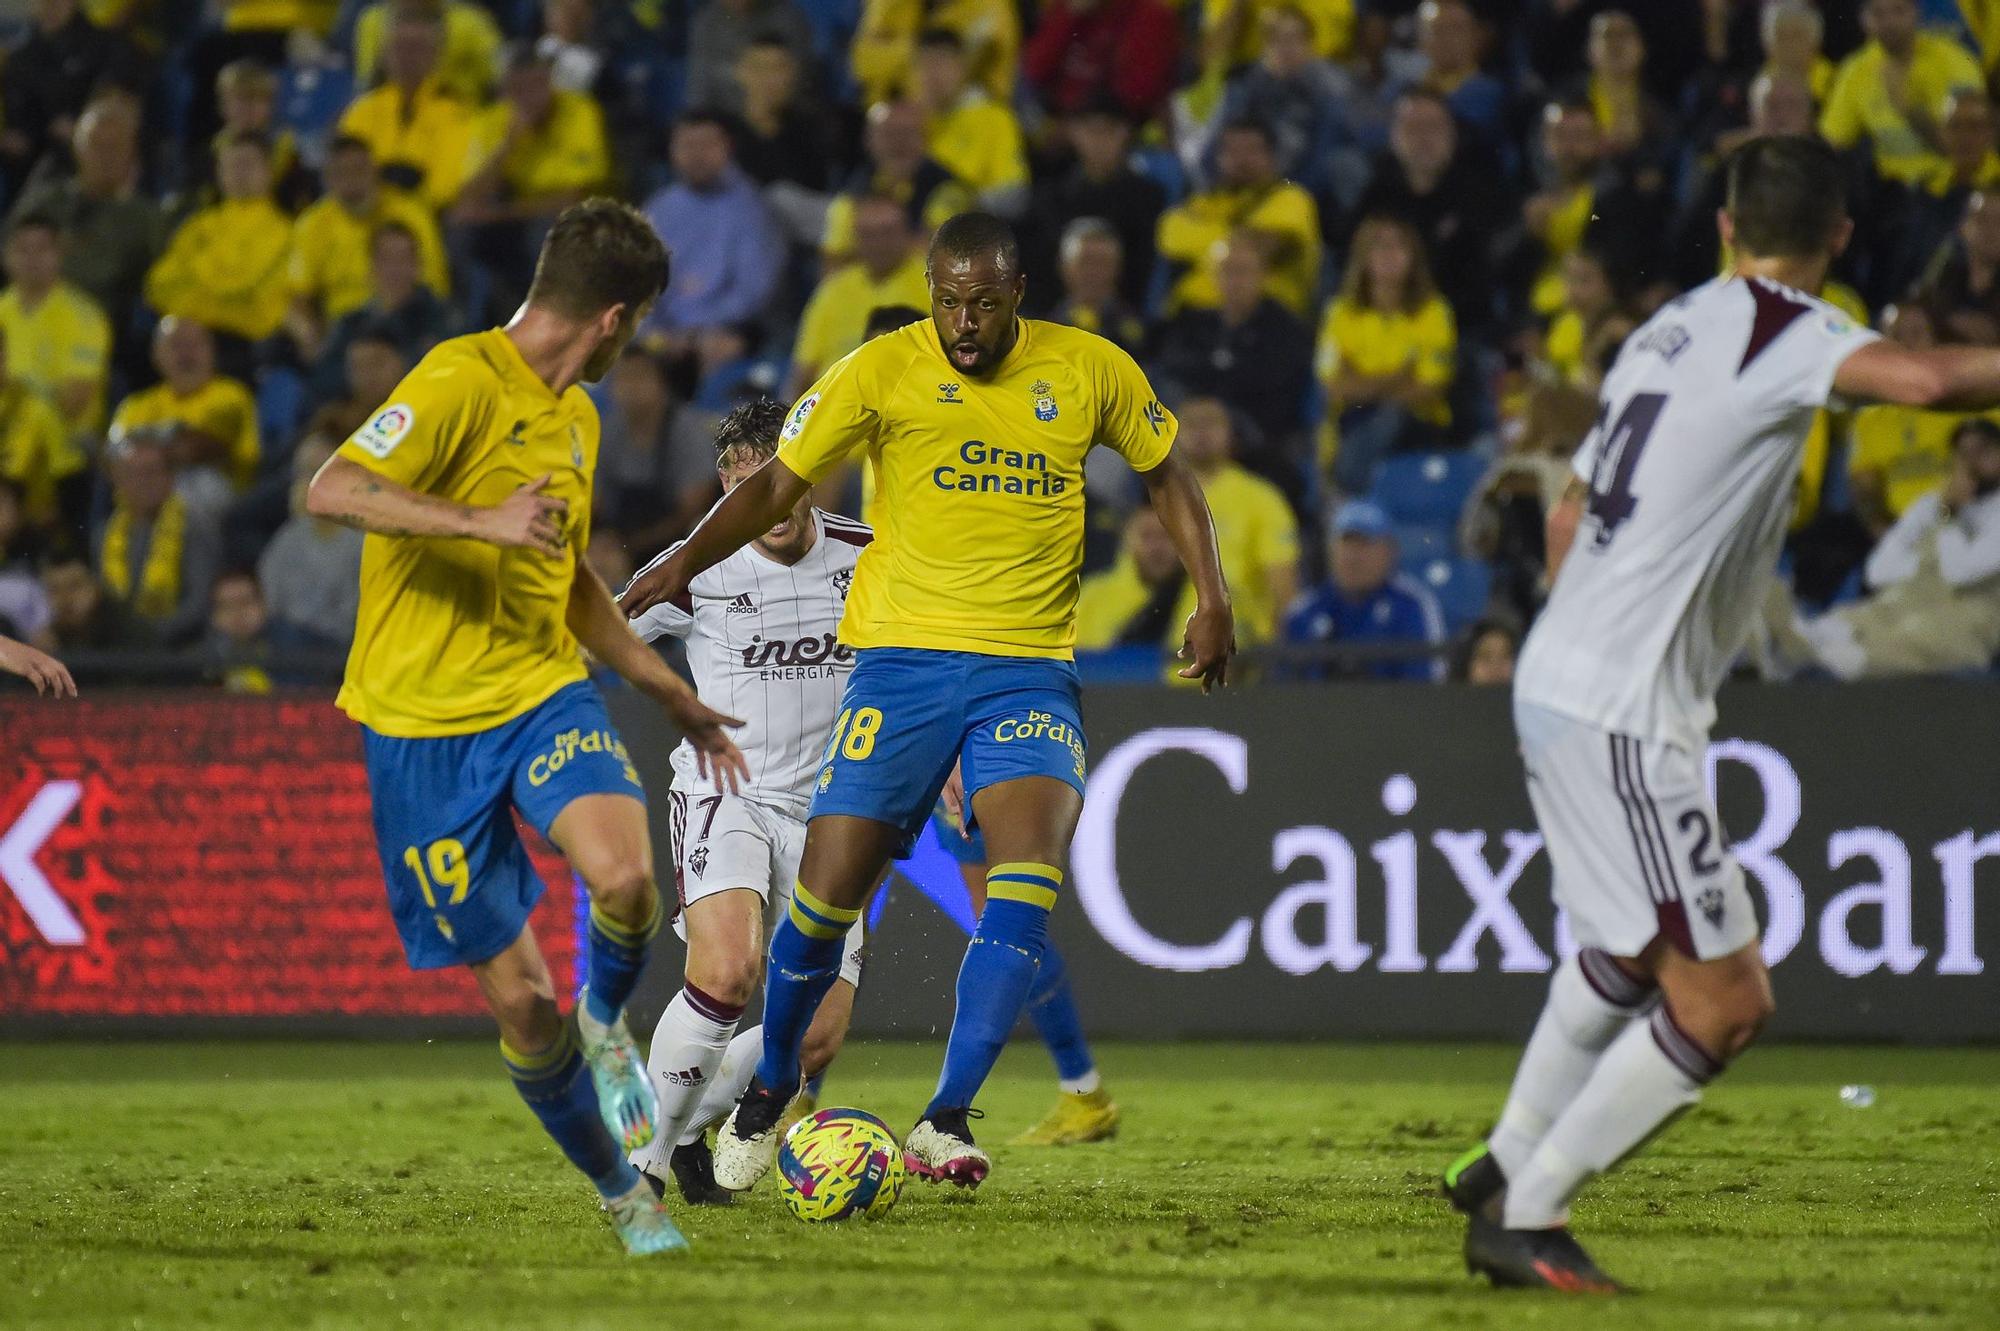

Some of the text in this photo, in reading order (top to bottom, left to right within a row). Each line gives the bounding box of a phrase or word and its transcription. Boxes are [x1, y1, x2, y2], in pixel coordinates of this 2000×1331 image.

[960, 440, 1046, 471] Gran
[933, 466, 1065, 496] Canaria
[726, 605, 758, 614] adidas
[1028, 710, 1052, 722] be
[824, 707, 883, 761] 18
[696, 795, 723, 843] 7
[1677, 808, 1730, 877] 2
[404, 838, 470, 908] 19
[662, 1070, 708, 1088] adidas
